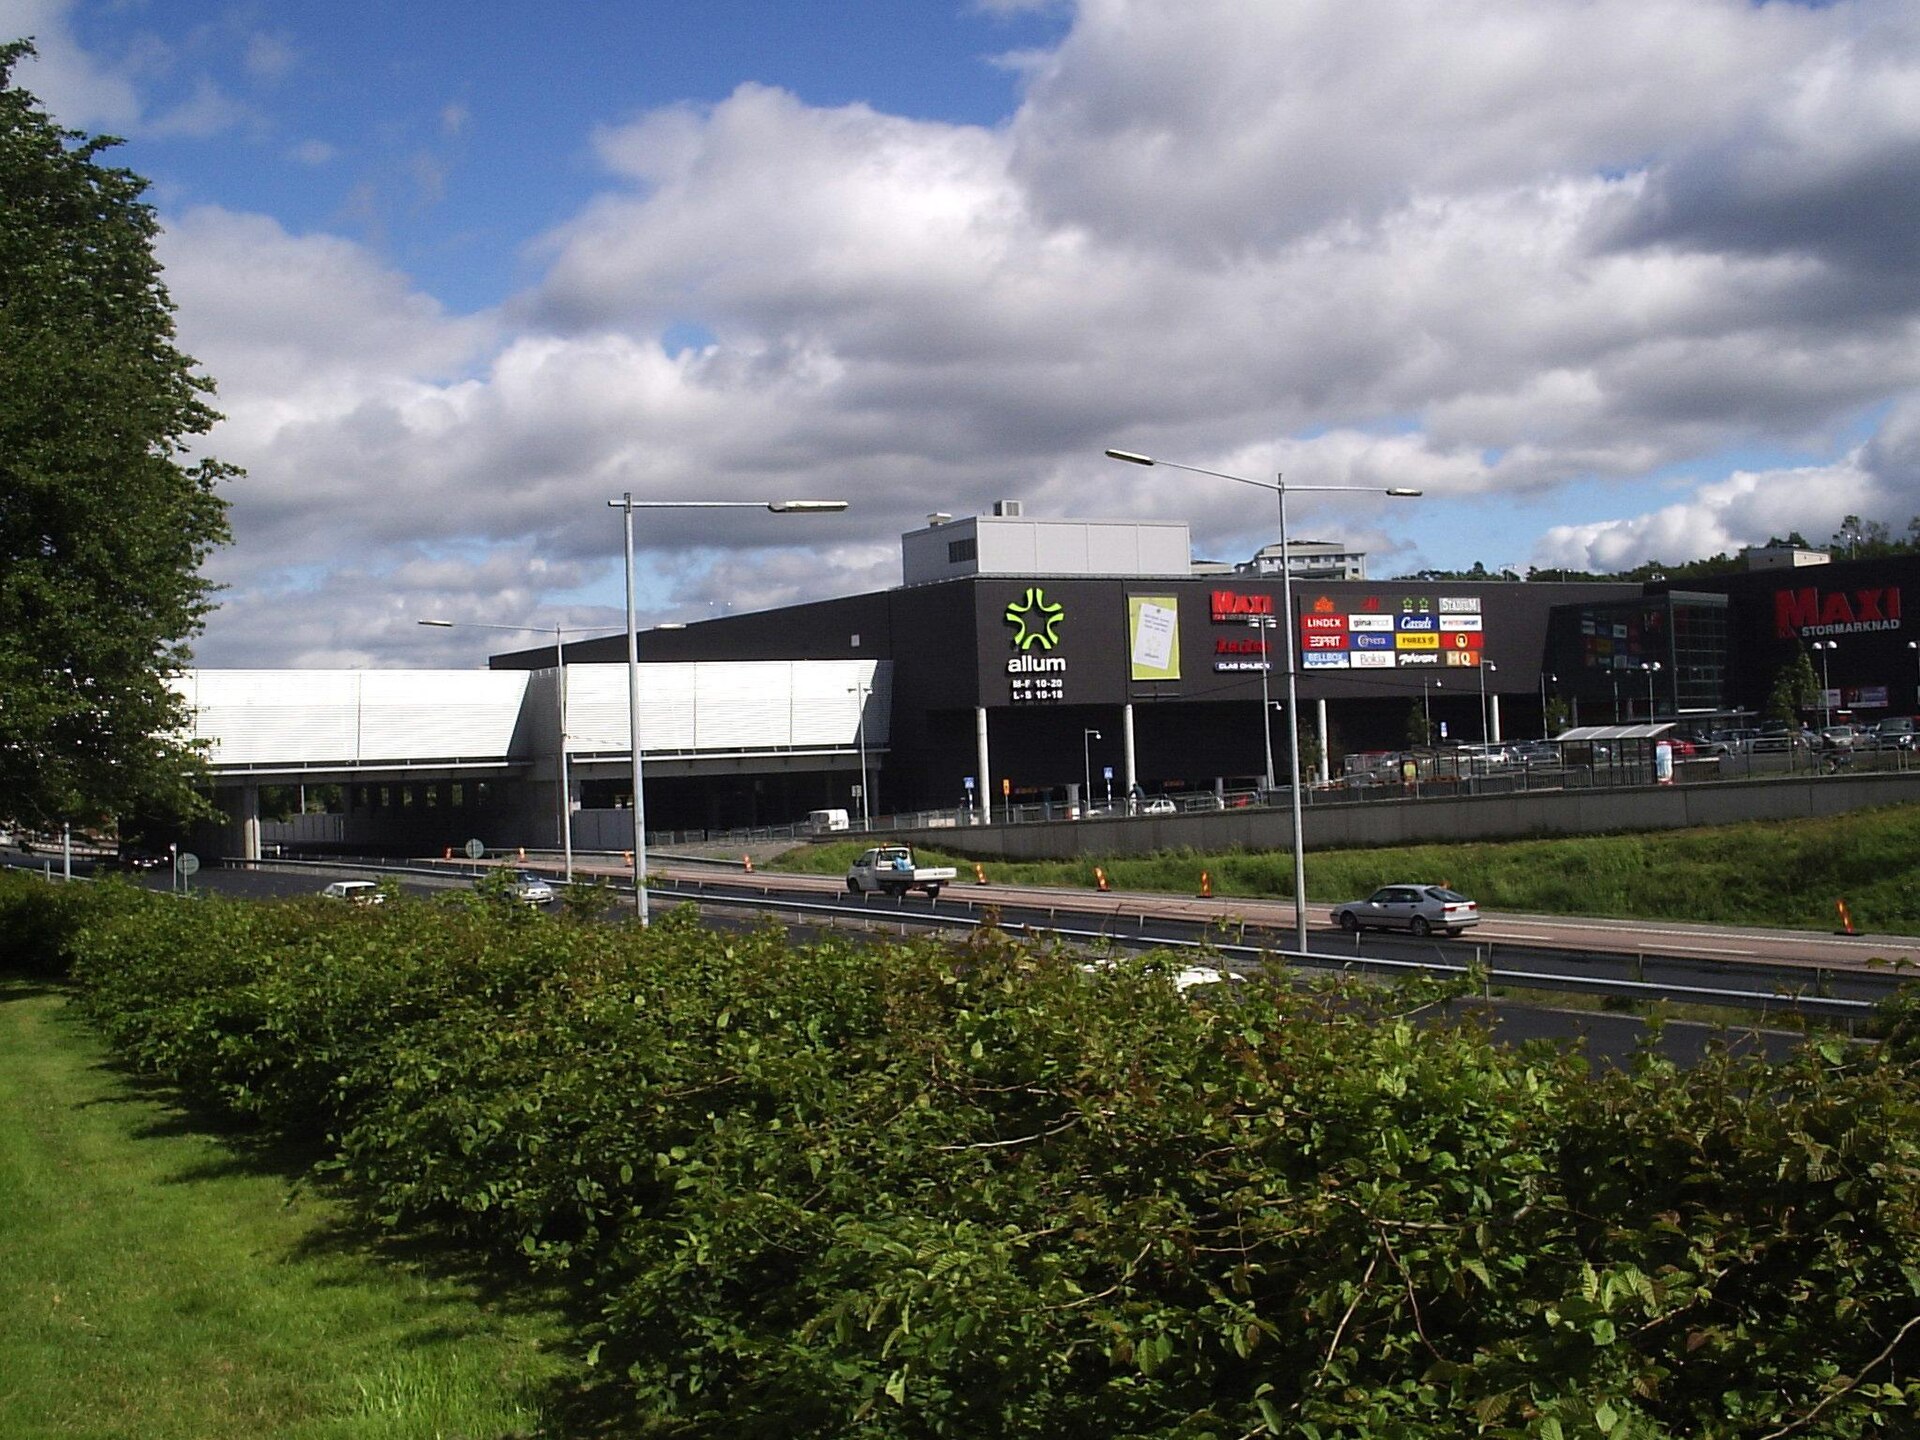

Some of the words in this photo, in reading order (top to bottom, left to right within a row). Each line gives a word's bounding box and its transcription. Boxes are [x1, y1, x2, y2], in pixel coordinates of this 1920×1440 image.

[1212, 590, 1273, 613] MAXI
[1442, 599, 1477, 611] STADIUM
[1776, 587, 1901, 631] MAXI
[1307, 618, 1341, 627] LINDEX
[1401, 617, 1431, 629] Cassels
[1802, 619, 1901, 637] STORMARKNAD
[1309, 635, 1341, 647] ESPRIT
[1008, 655, 1067, 673] allum
[1013, 679, 1031, 688] M-F
[1036, 679, 1063, 688] 10-20
